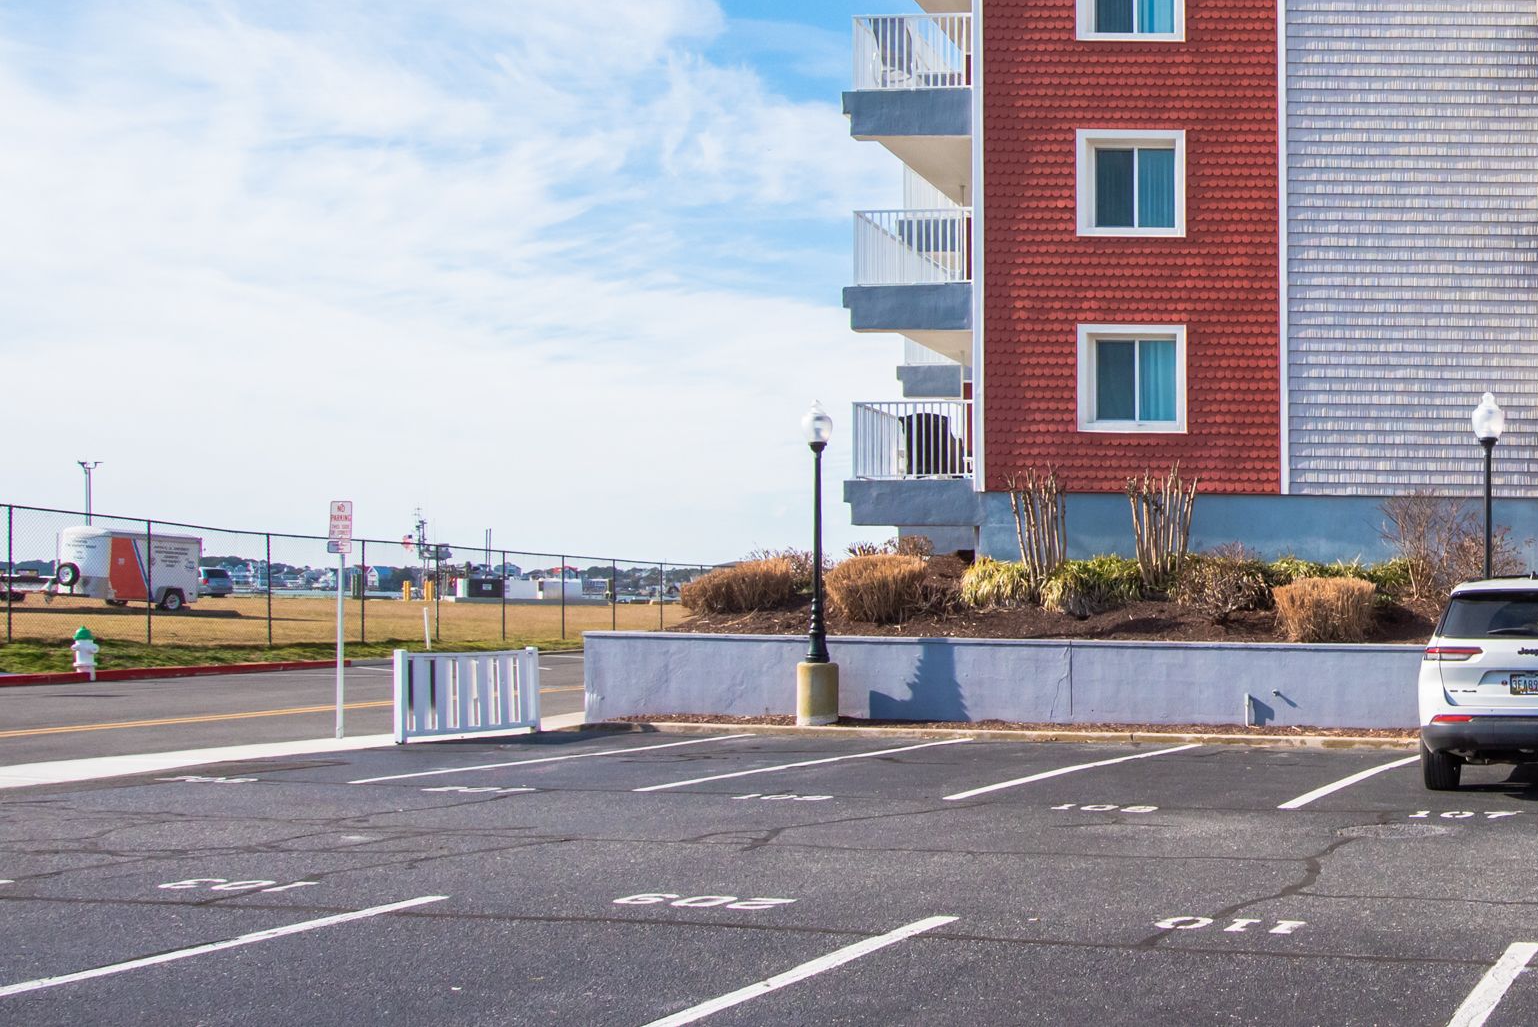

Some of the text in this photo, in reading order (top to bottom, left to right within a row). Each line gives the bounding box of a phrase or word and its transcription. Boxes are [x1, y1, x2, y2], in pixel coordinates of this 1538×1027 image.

[337, 503, 346, 513] NO
[330, 514, 352, 522] PARKING
[1408, 810, 1524, 820] 107
[157, 878, 318, 893] 103
[612, 893, 797, 910] 209
[1154, 916, 1307, 934] 110
